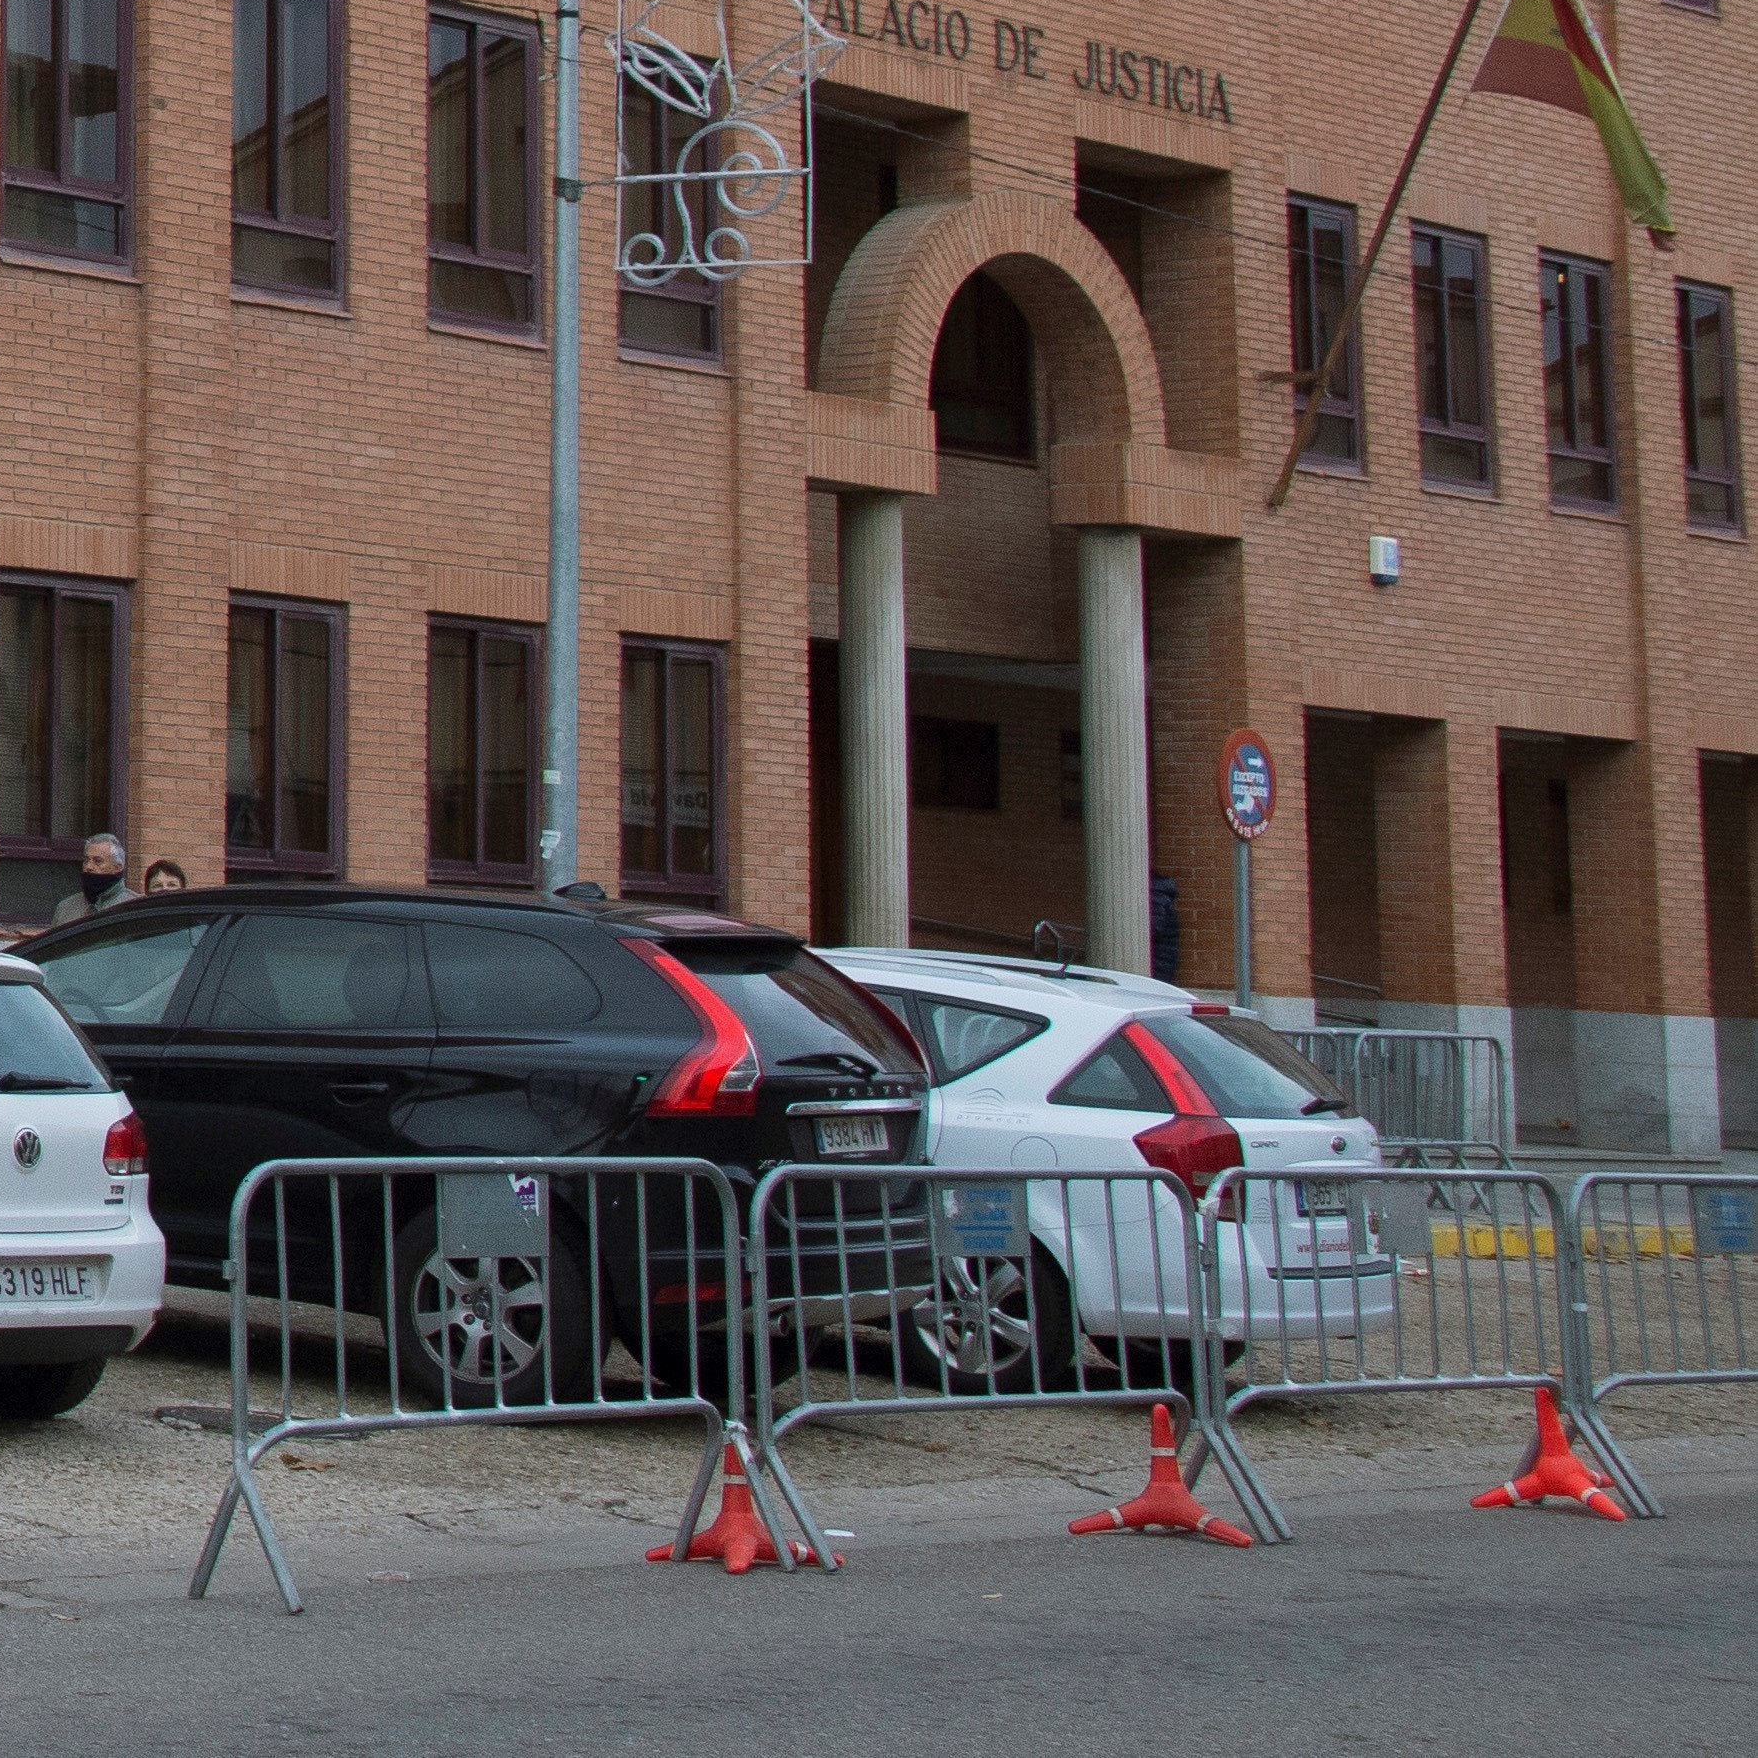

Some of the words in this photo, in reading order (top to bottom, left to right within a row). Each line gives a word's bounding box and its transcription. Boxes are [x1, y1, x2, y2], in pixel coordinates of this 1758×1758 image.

[994, 17, 1048, 80] DE
[1072, 39, 1235, 124] JUSTICIA
[828, 1085, 905, 1098] VOLVO
[824, 1122, 860, 1148] 9384
[109, 1184, 126, 1196] TDI
[50, 1266, 87, 1296] HLF
